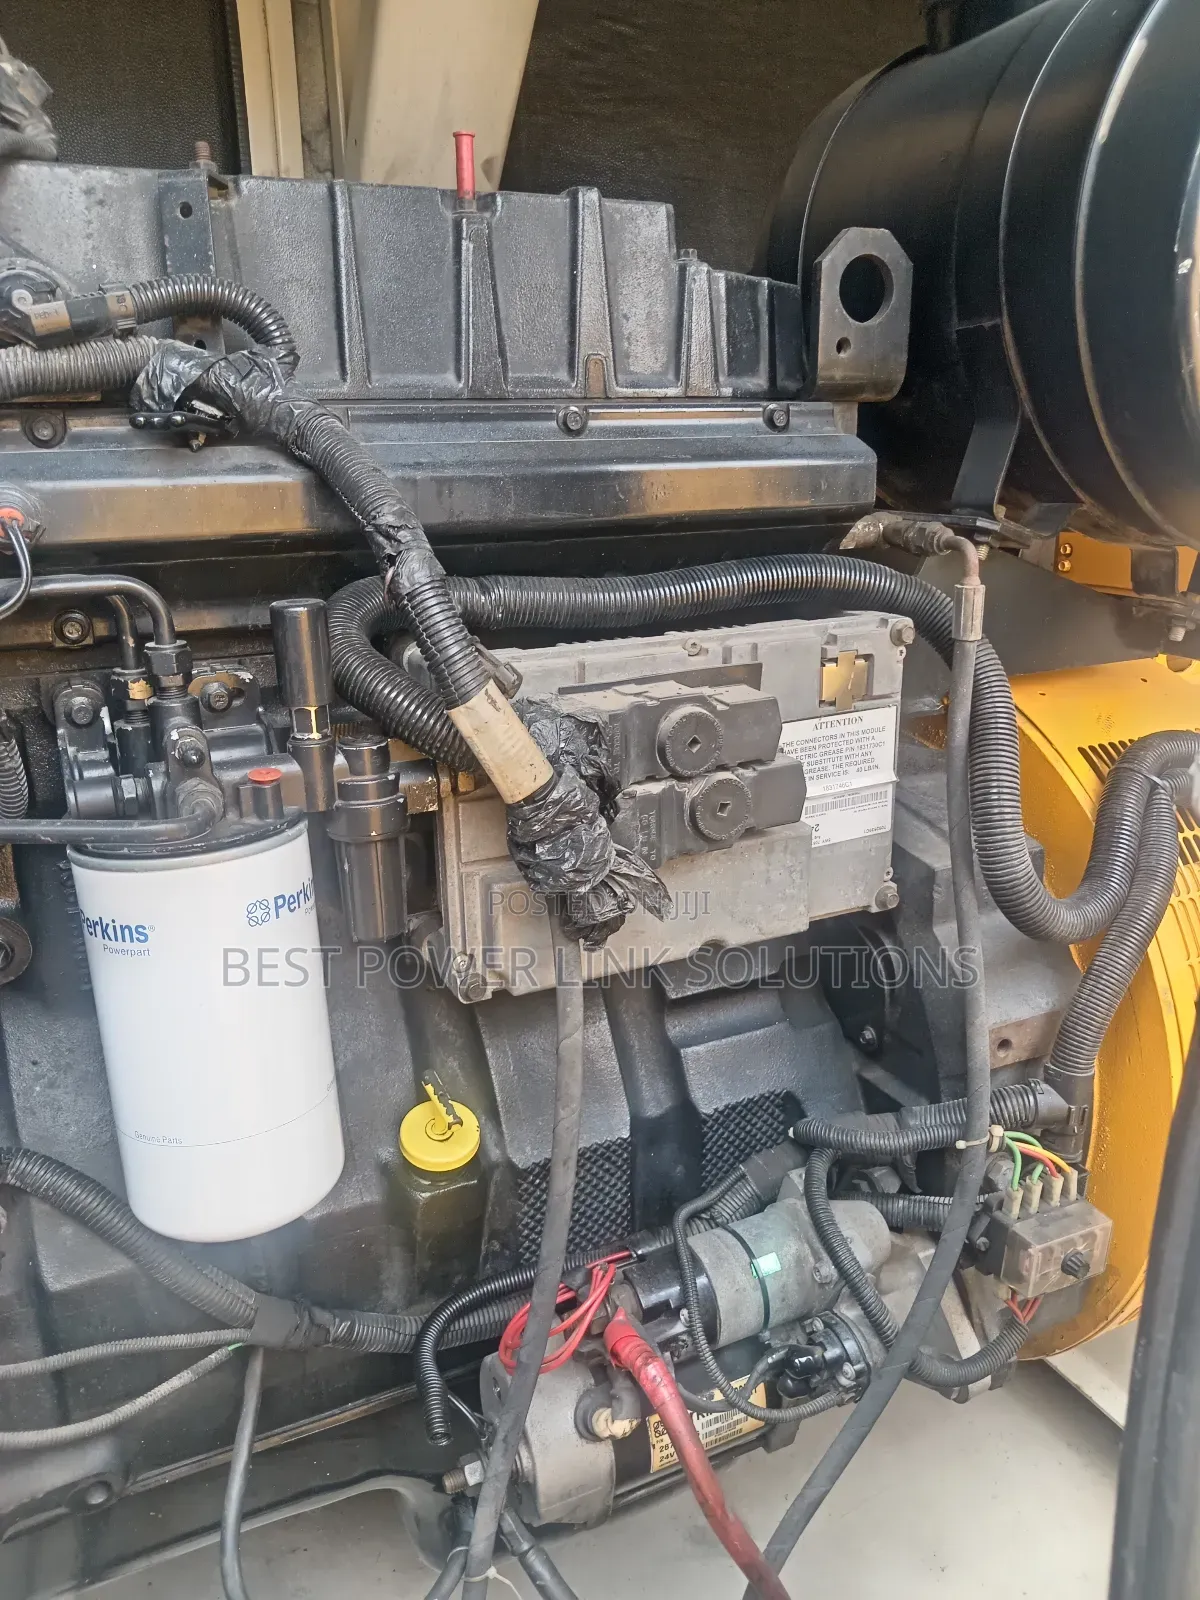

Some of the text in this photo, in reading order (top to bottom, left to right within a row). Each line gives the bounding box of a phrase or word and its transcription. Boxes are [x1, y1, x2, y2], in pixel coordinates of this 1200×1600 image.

[812, 715, 864, 731] ATTENTION
[782, 740, 795, 748] THE
[795, 733, 838, 745] CONNECTORS
[861, 725, 886, 735] MODULE
[799, 745, 817, 753] BEEN
[817, 739, 854, 751] PROTECTED
[855, 736, 870, 744] WITH
[820, 747, 844, 757] GREASE
[806, 755, 843, 767] SUBSTITUTE
[844, 752, 860, 761] WITH
[860, 750, 873, 758] ANY
[832, 761, 844, 770] THE
[844, 757, 876, 769] REQUIRED
[816, 770, 841, 781] SERVICE
[102, 943, 151, 958] Powerpart
[162, 1135, 183, 1145] Parts
